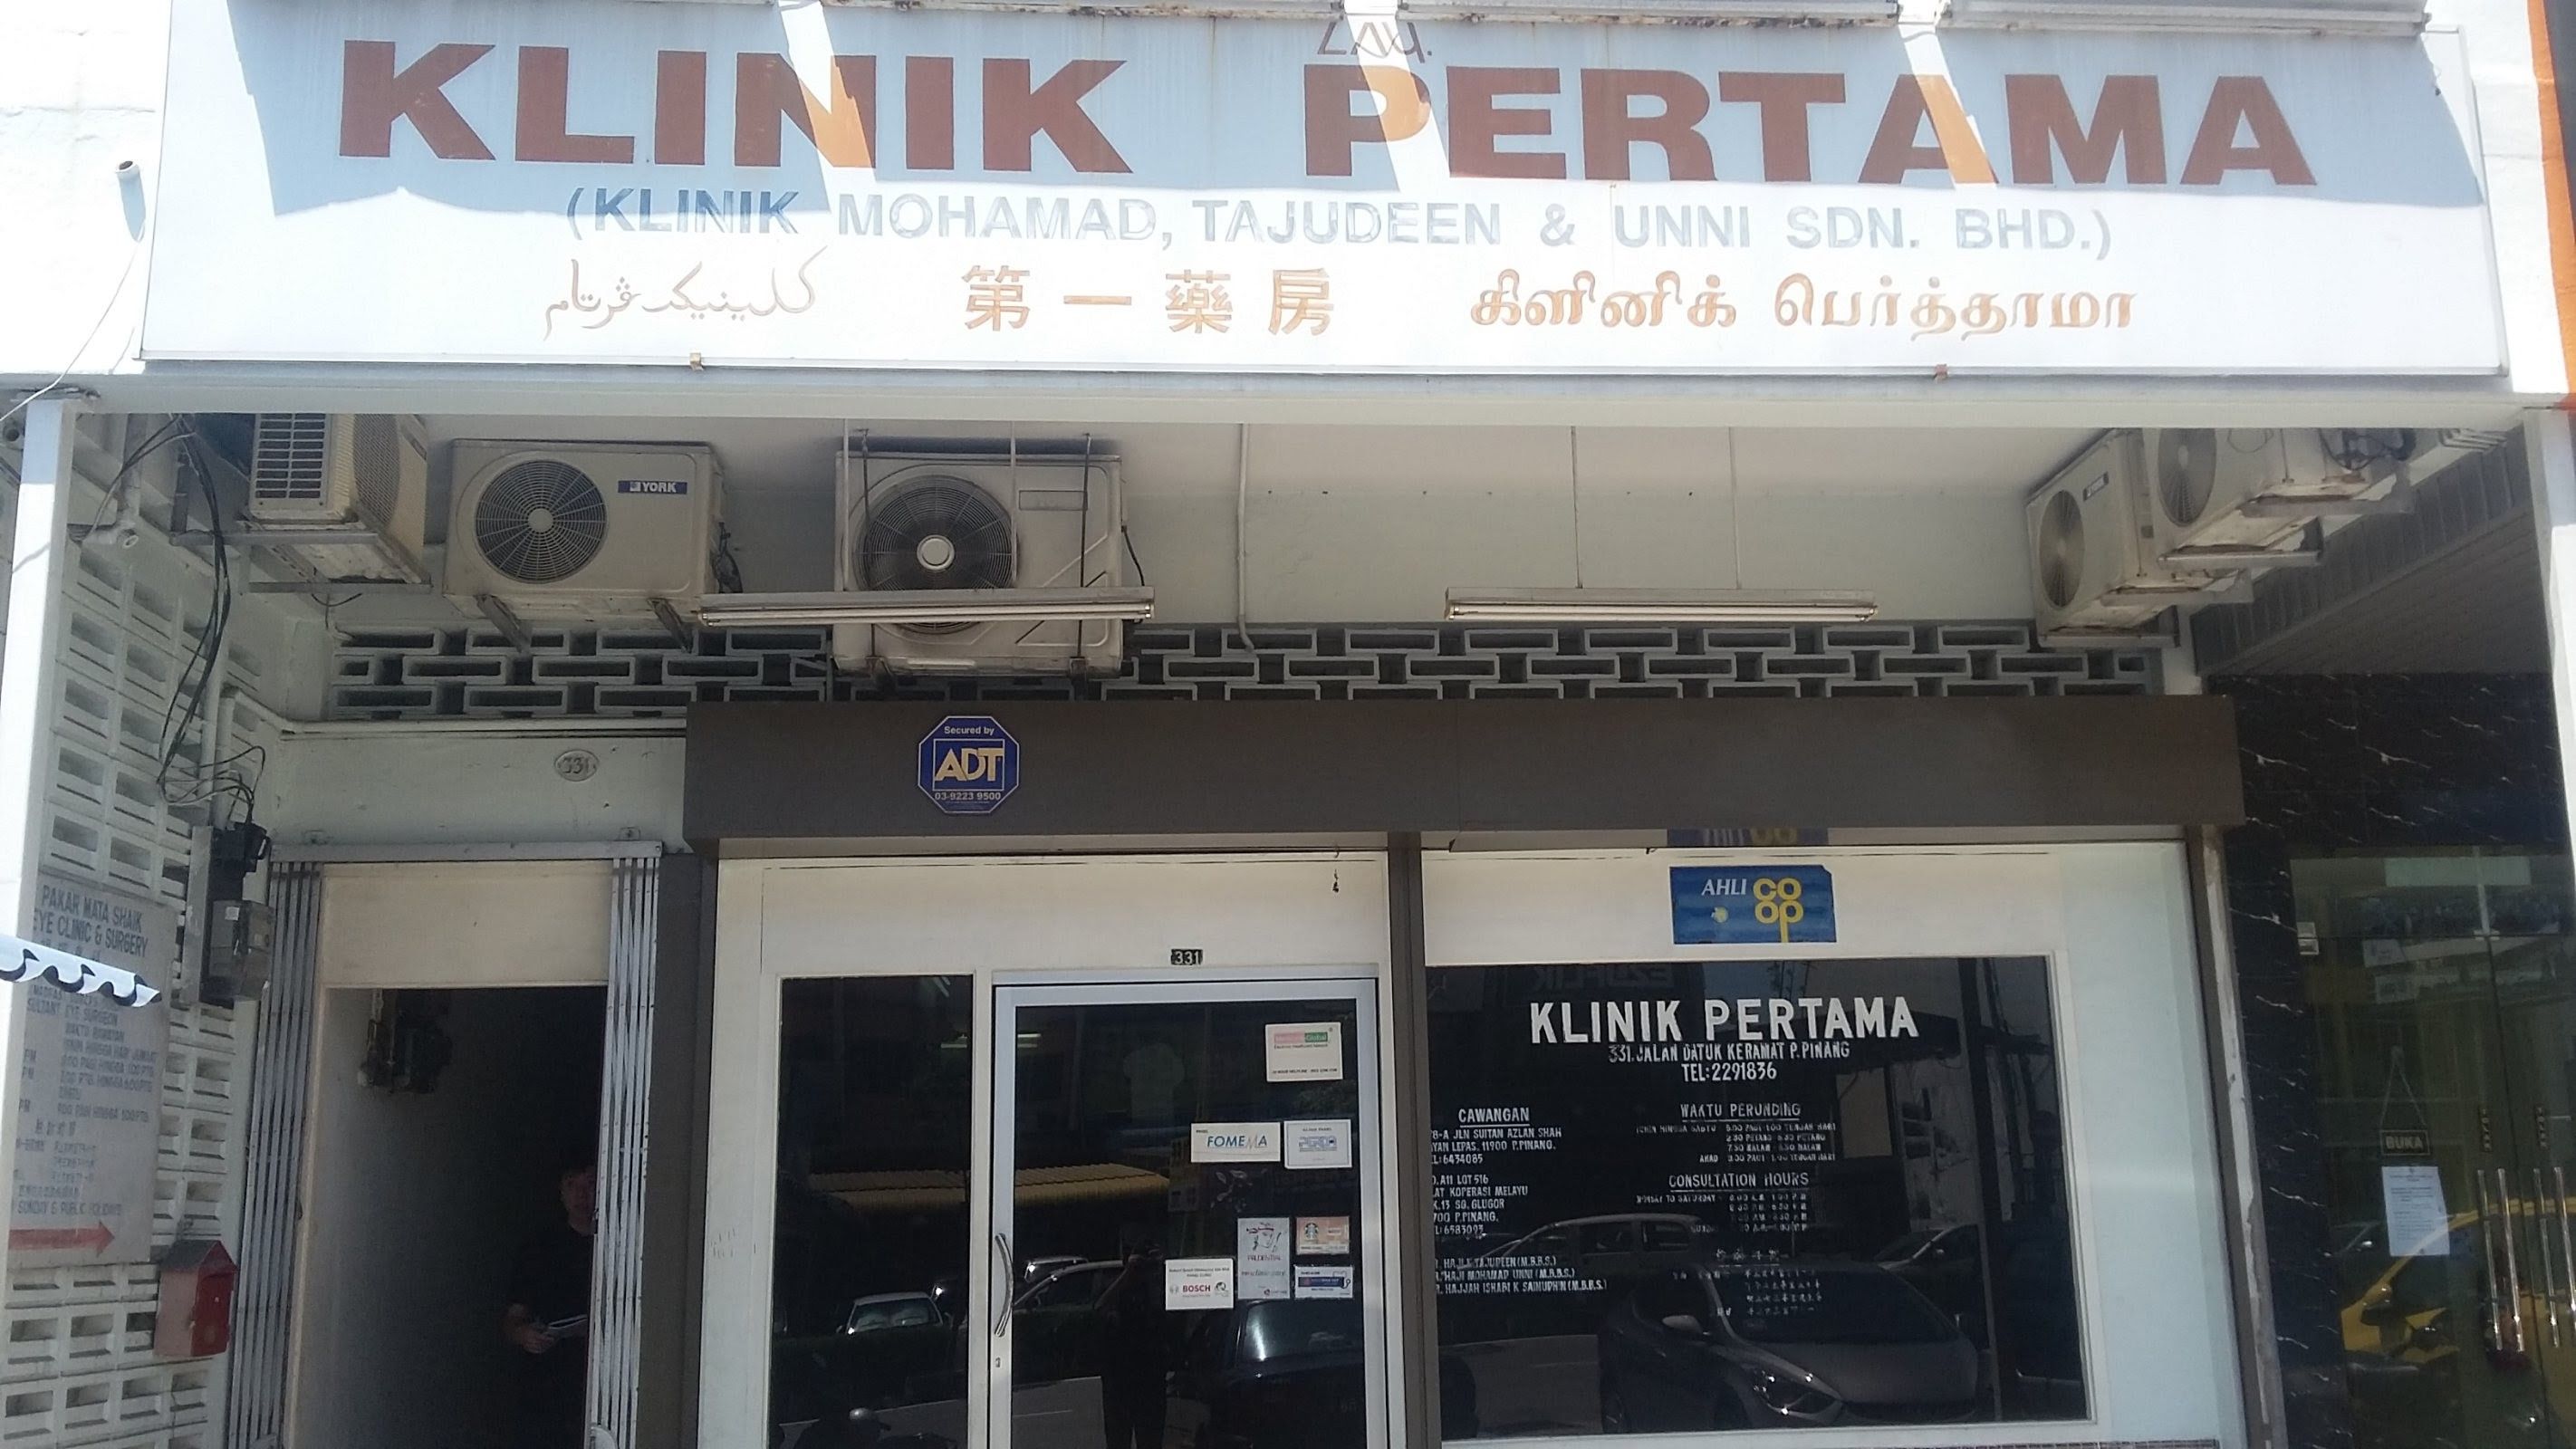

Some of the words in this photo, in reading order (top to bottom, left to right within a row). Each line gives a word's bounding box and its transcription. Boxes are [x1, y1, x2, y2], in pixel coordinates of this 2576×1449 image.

[340, 40, 1133, 173] KLINIK
[1304, 63, 2317, 186] PERTAMA
[567, 187, 799, 240] (KLINIK
[839, 193, 1172, 250] MOHAMAD,
[1192, 199, 1501, 246] TAJUDEEN
[1540, 204, 1575, 246] &
[1615, 205, 1750, 247] UNNI
[1786, 206, 1919, 249] SDN.
[1956, 207, 2110, 260] BHD.)
[962, 265, 1334, 335] 第一藥房
[1471, 268, 1736, 327] கிளினிக்
[642, 482, 677, 493] YORK
[944, 726, 981, 734] Secured
[984, 726, 995, 736] by
[935, 748, 1004, 782] ADT
[976, 792, 1001, 800] 9500
[1701, 878, 1747, 896] AHLI
[43, 885, 80, 915] PAKAR
[83, 897, 109, 923] MATA
[58, 916, 91, 943] CLINIC
[95, 926, 102, 945] &
[106, 928, 149, 957] SURGERY
[1175, 951, 1199, 964] 331
[1531, 1000, 1682, 1043] KLINIK
[1705, 996, 1919, 1041] PERTAMA
[1683, 1043, 1722, 1061] DATUK
[1726, 1042, 1785, 1060] KERAMAT
[1458, 1108, 1530, 1122] CAWANGAN
[1680, 1103, 1722, 1118] WAKTU
[1730, 1102, 1801, 1117] PERUNDING
[1453, 1129, 1469, 1139] JLN
[1507, 1128, 1535, 1138] AZLAN
[1537, 1128, 1562, 1137] SHAH
[1431, 1141, 1448, 1152] YAN
[1482, 1140, 1507, 1151] 11900
[2386, 1136, 2424, 1149] BUKA
[1432, 1154, 1484, 1164] L:6434085
[1457, 1175, 1473, 1185] LOT
[1474, 1175, 1489, 1185] 516
[1669, 1173, 1756, 1188] CONSULTATION
[1764, 1172, 1810, 1186] HOURS
[1433, 1187, 1445, 1197] AT
[1449, 1186, 1491, 1196] KOPERASI
[1495, 1185, 1528, 1195] MELAYU
[1471, 1198, 1504, 1209] GLUGOR
[1446, 1282, 1480, 1293] HAJJAH
